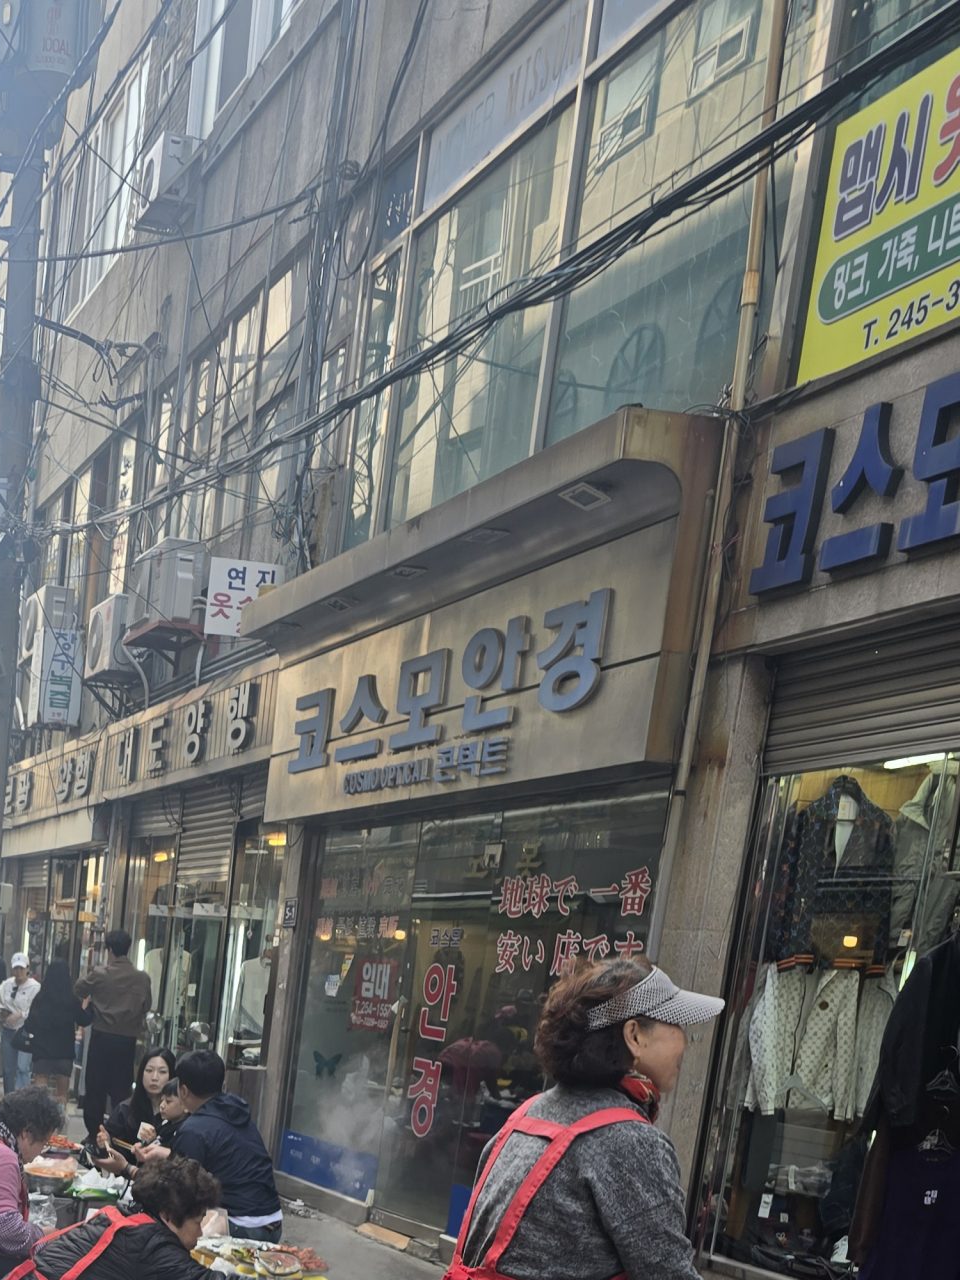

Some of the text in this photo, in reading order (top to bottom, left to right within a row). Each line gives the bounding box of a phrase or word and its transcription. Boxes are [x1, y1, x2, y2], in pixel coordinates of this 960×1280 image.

[833, 92, 933, 241] 맵시
[834, 253, 870, 309] 밍크,
[878, 226, 919, 281] 가죽,
[118, 681, 251, 787] 대도양행
[288, 587, 614, 776] 코스모안경
[362, 962, 390, 999] 임대
[430, 928, 463, 948] 코스모
[408, 962, 457, 1138] 안경
